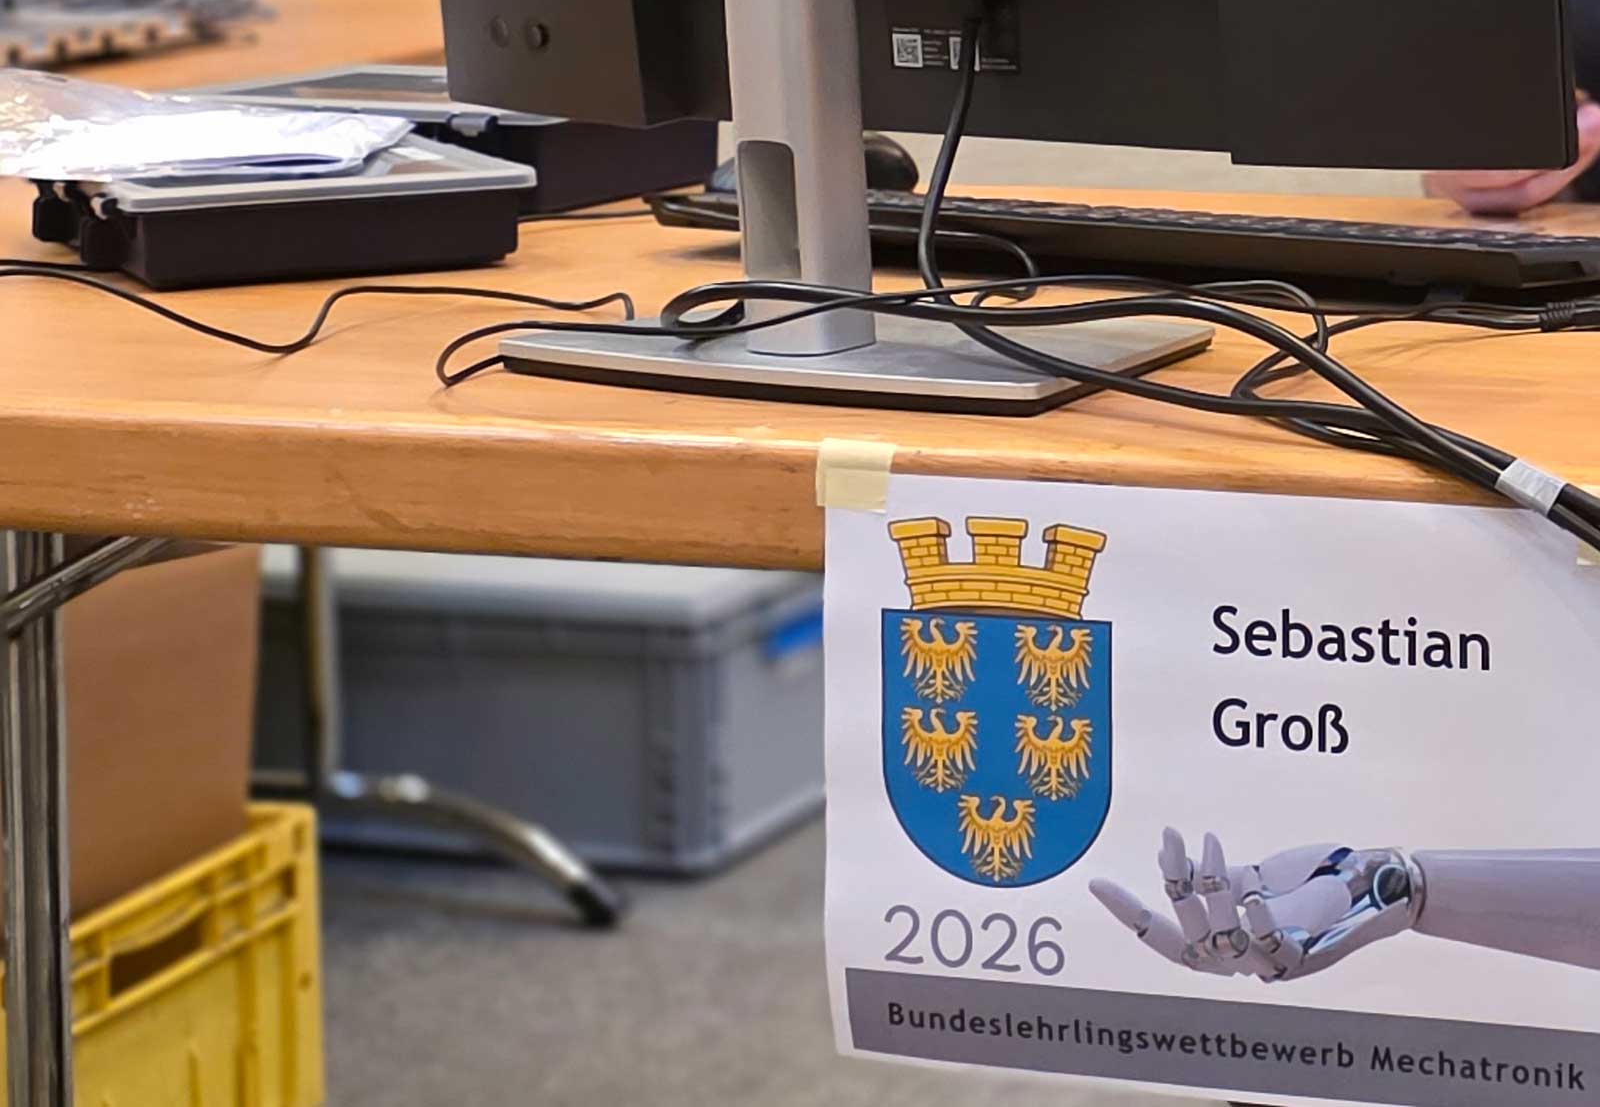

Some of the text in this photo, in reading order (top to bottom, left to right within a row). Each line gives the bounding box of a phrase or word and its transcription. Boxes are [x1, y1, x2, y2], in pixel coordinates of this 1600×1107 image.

[1212, 605, 1490, 671] Sebastian
[1212, 698, 1349, 754] Groß
[884, 905, 1065, 976] 2026
[888, 1002, 1585, 1091] Bundeslehrlingswettbewerb Mechatronik
